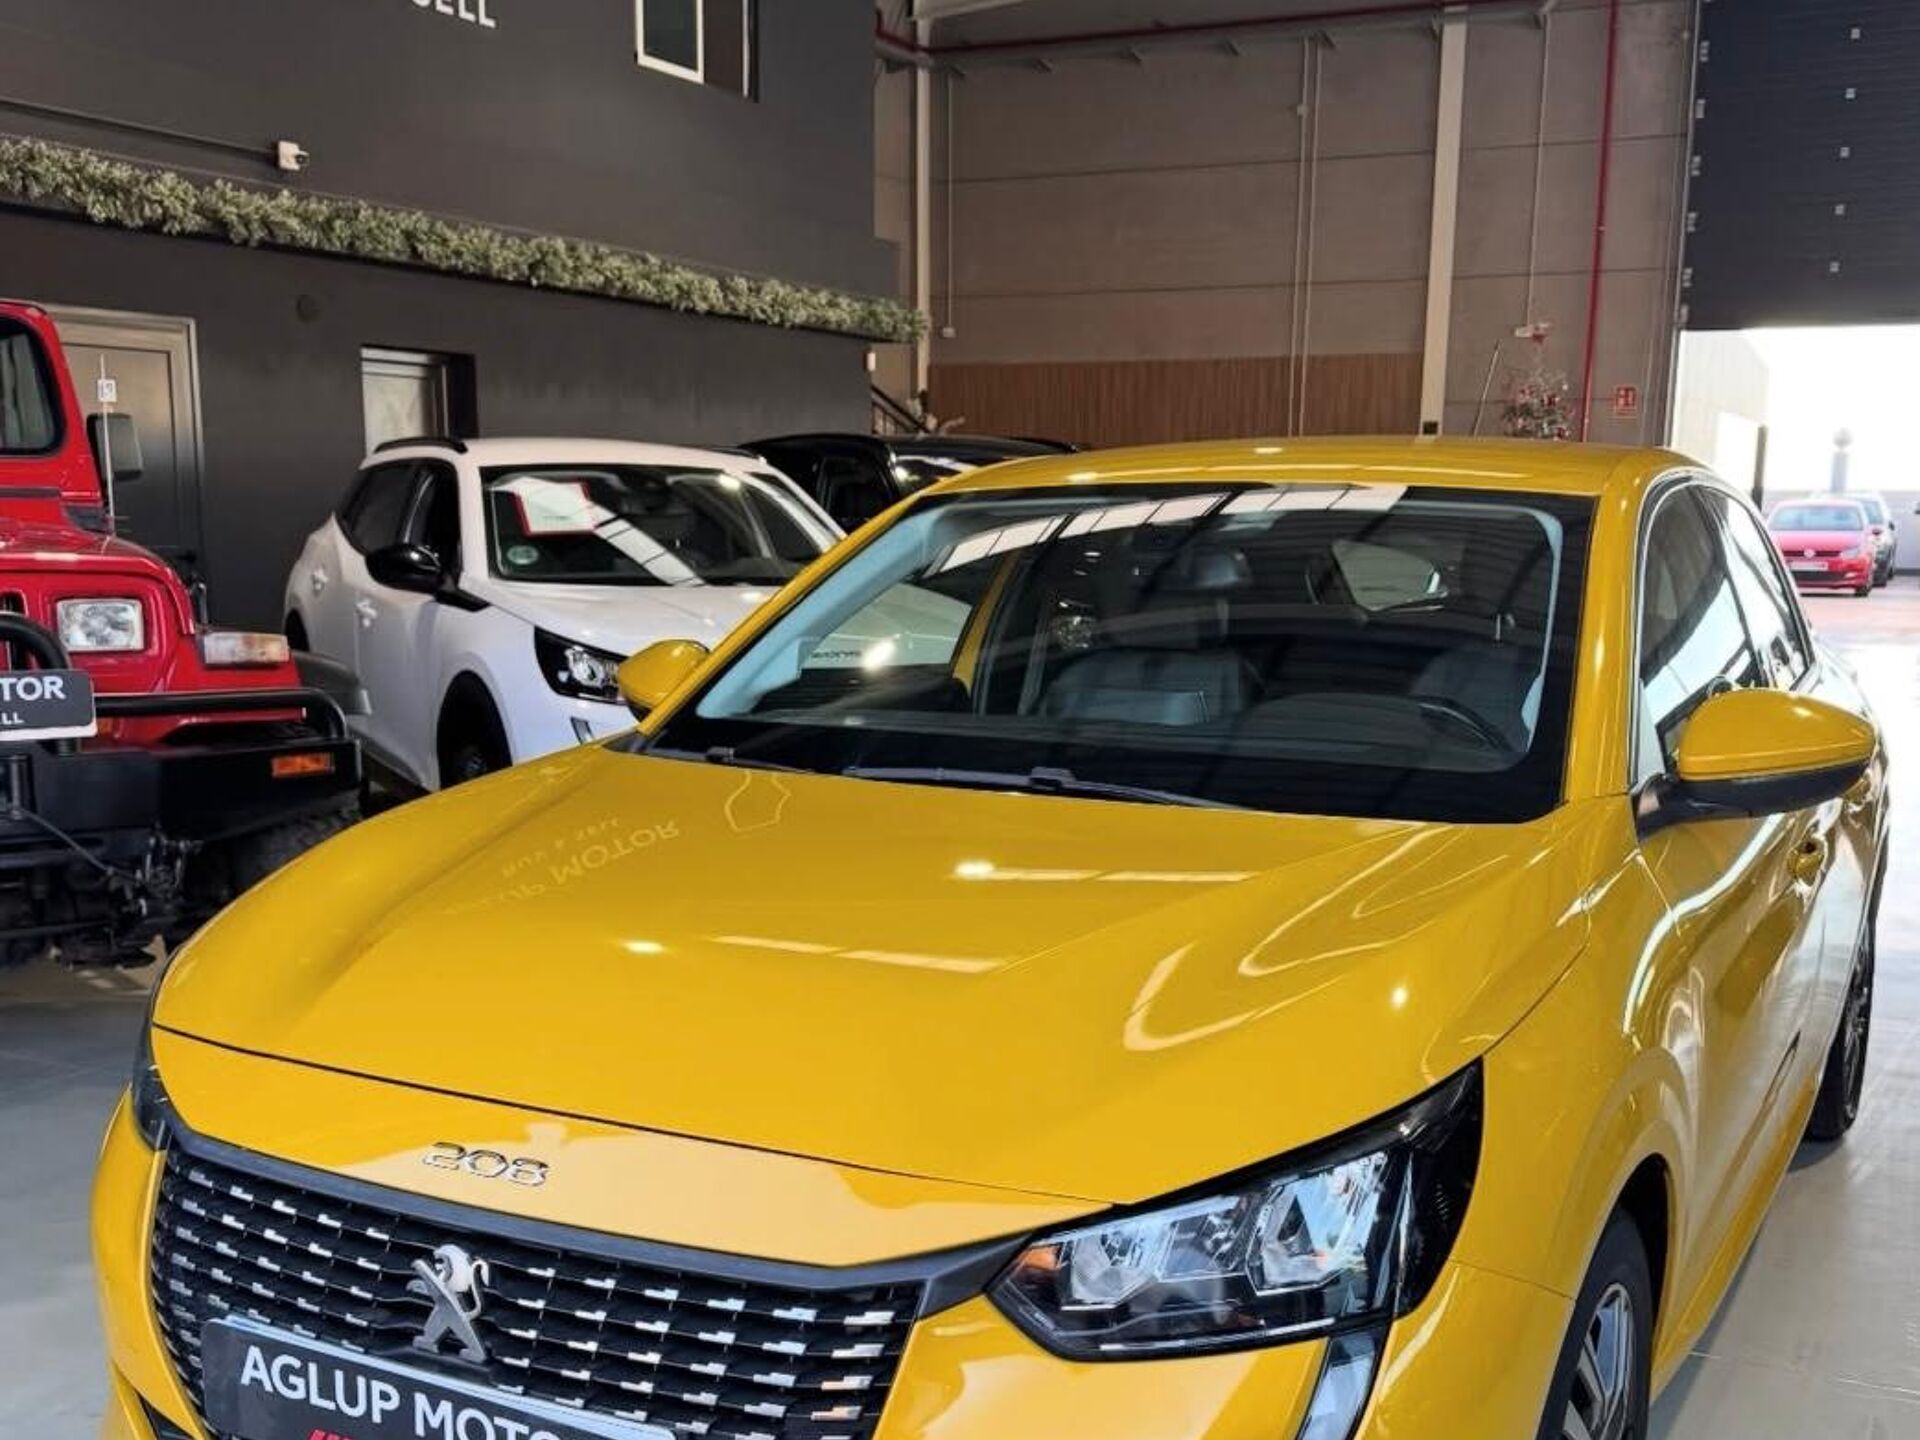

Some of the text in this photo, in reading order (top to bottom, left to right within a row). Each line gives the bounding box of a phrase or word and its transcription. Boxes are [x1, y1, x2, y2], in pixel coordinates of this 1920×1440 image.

[412, 0, 496, 28] LL
[422, 1141, 549, 1187] 208
[240, 1344, 562, 1440] AGLUP MOT
